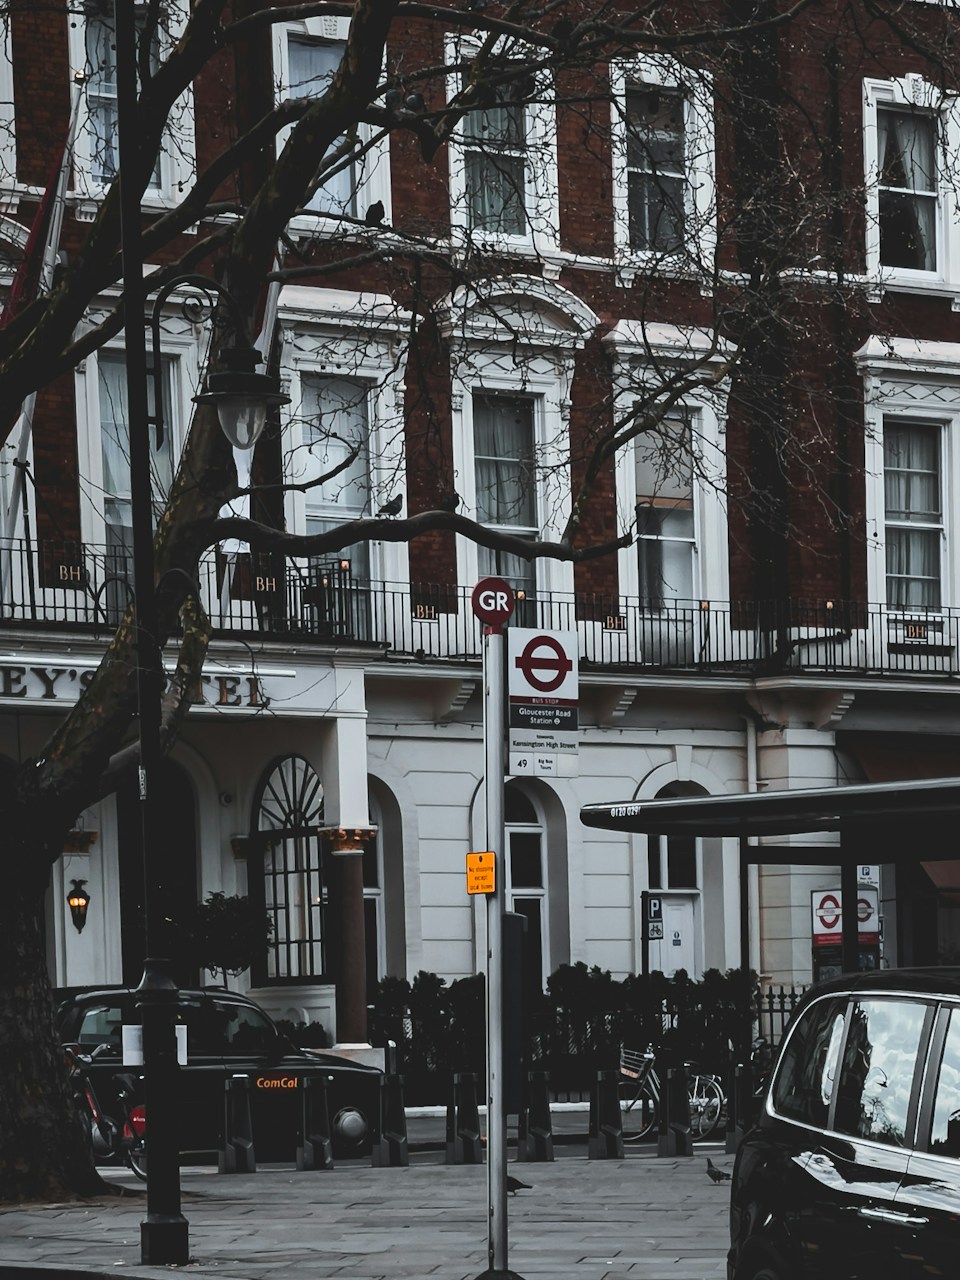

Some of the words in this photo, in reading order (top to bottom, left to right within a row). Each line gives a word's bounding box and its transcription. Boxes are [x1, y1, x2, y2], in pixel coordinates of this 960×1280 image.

[59, 565, 81, 581] BH
[256, 576, 276, 592] BH
[478, 590, 509, 612] GR
[416, 605, 435, 619] BH
[606, 616, 624, 630] BH
[907, 625, 925, 639] BH
[518, 707, 555, 717] Gloucester
[555, 710, 571, 718] Road
[512, 740, 545, 749] Kensington
[517, 759, 528, 768] 49
[650, 899, 660, 917] P
